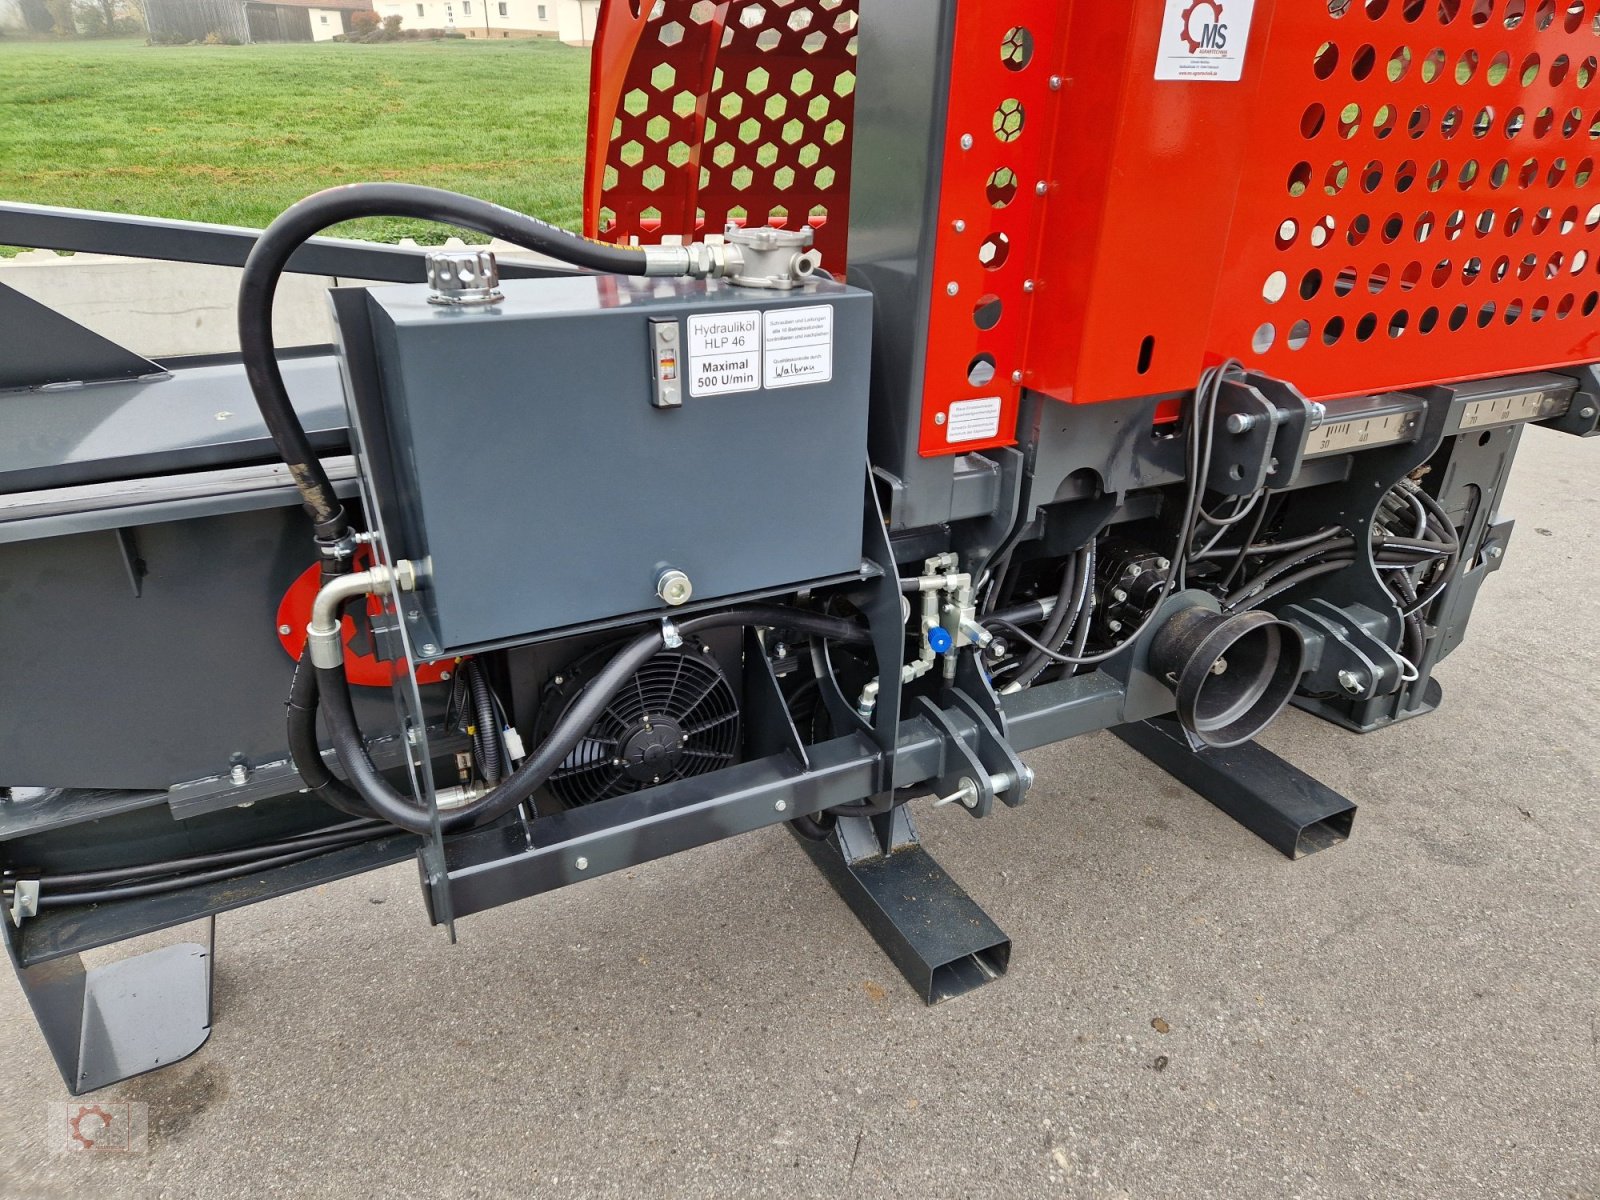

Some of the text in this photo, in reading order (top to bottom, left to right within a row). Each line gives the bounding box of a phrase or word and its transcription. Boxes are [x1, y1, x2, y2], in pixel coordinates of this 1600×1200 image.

[1200, 23, 1228, 49] MS
[694, 320, 756, 337] Hydrauliköl
[704, 335, 746, 349] HLP 46
[702, 359, 749, 374] Maximal
[697, 373, 754, 388] 500 U/min
[1320, 440, 1329, 449] 30
